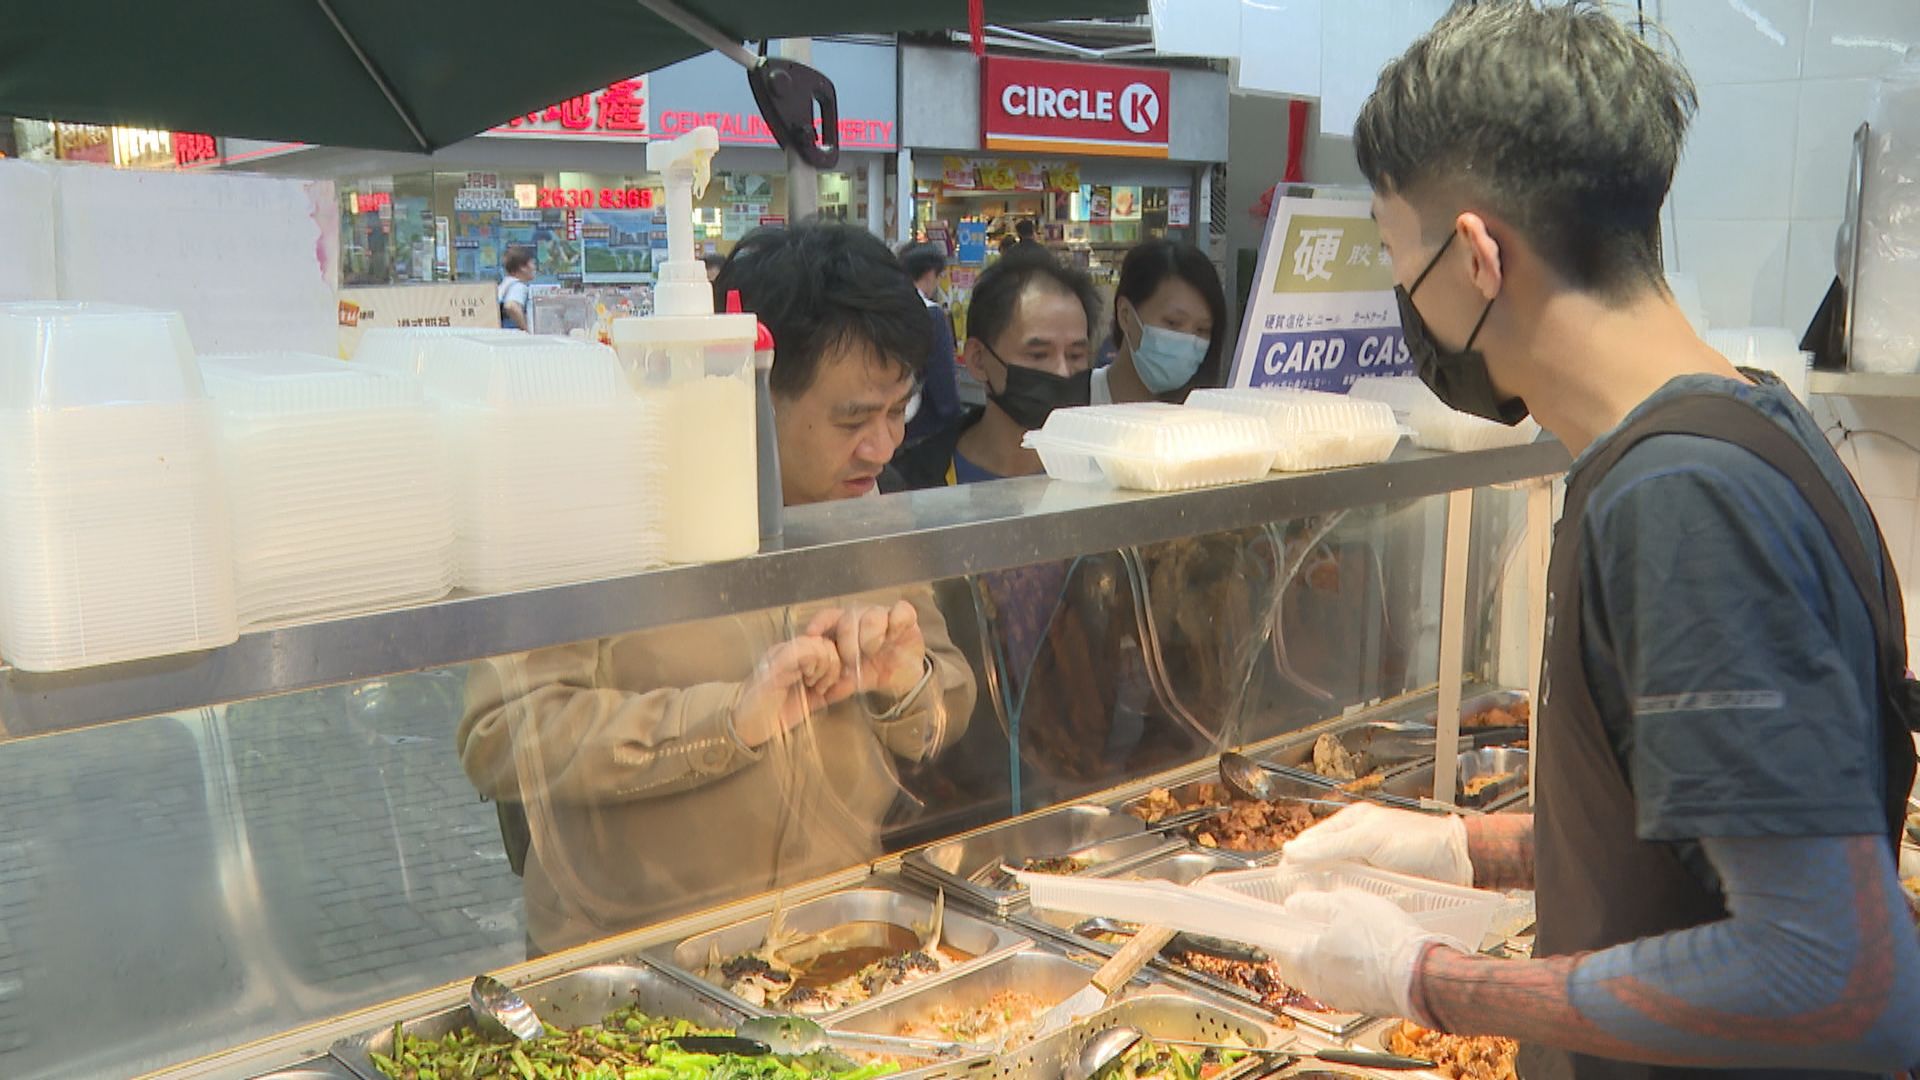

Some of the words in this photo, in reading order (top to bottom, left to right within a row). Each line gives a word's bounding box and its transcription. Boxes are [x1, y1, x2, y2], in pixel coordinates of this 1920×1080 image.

[1001, 83, 1113, 122] CIRCLE
[1128, 87, 1157, 132] K
[537, 187, 595, 209] 2630
[1264, 339, 1346, 376] CARD
[1358, 335, 1413, 368] CAS
